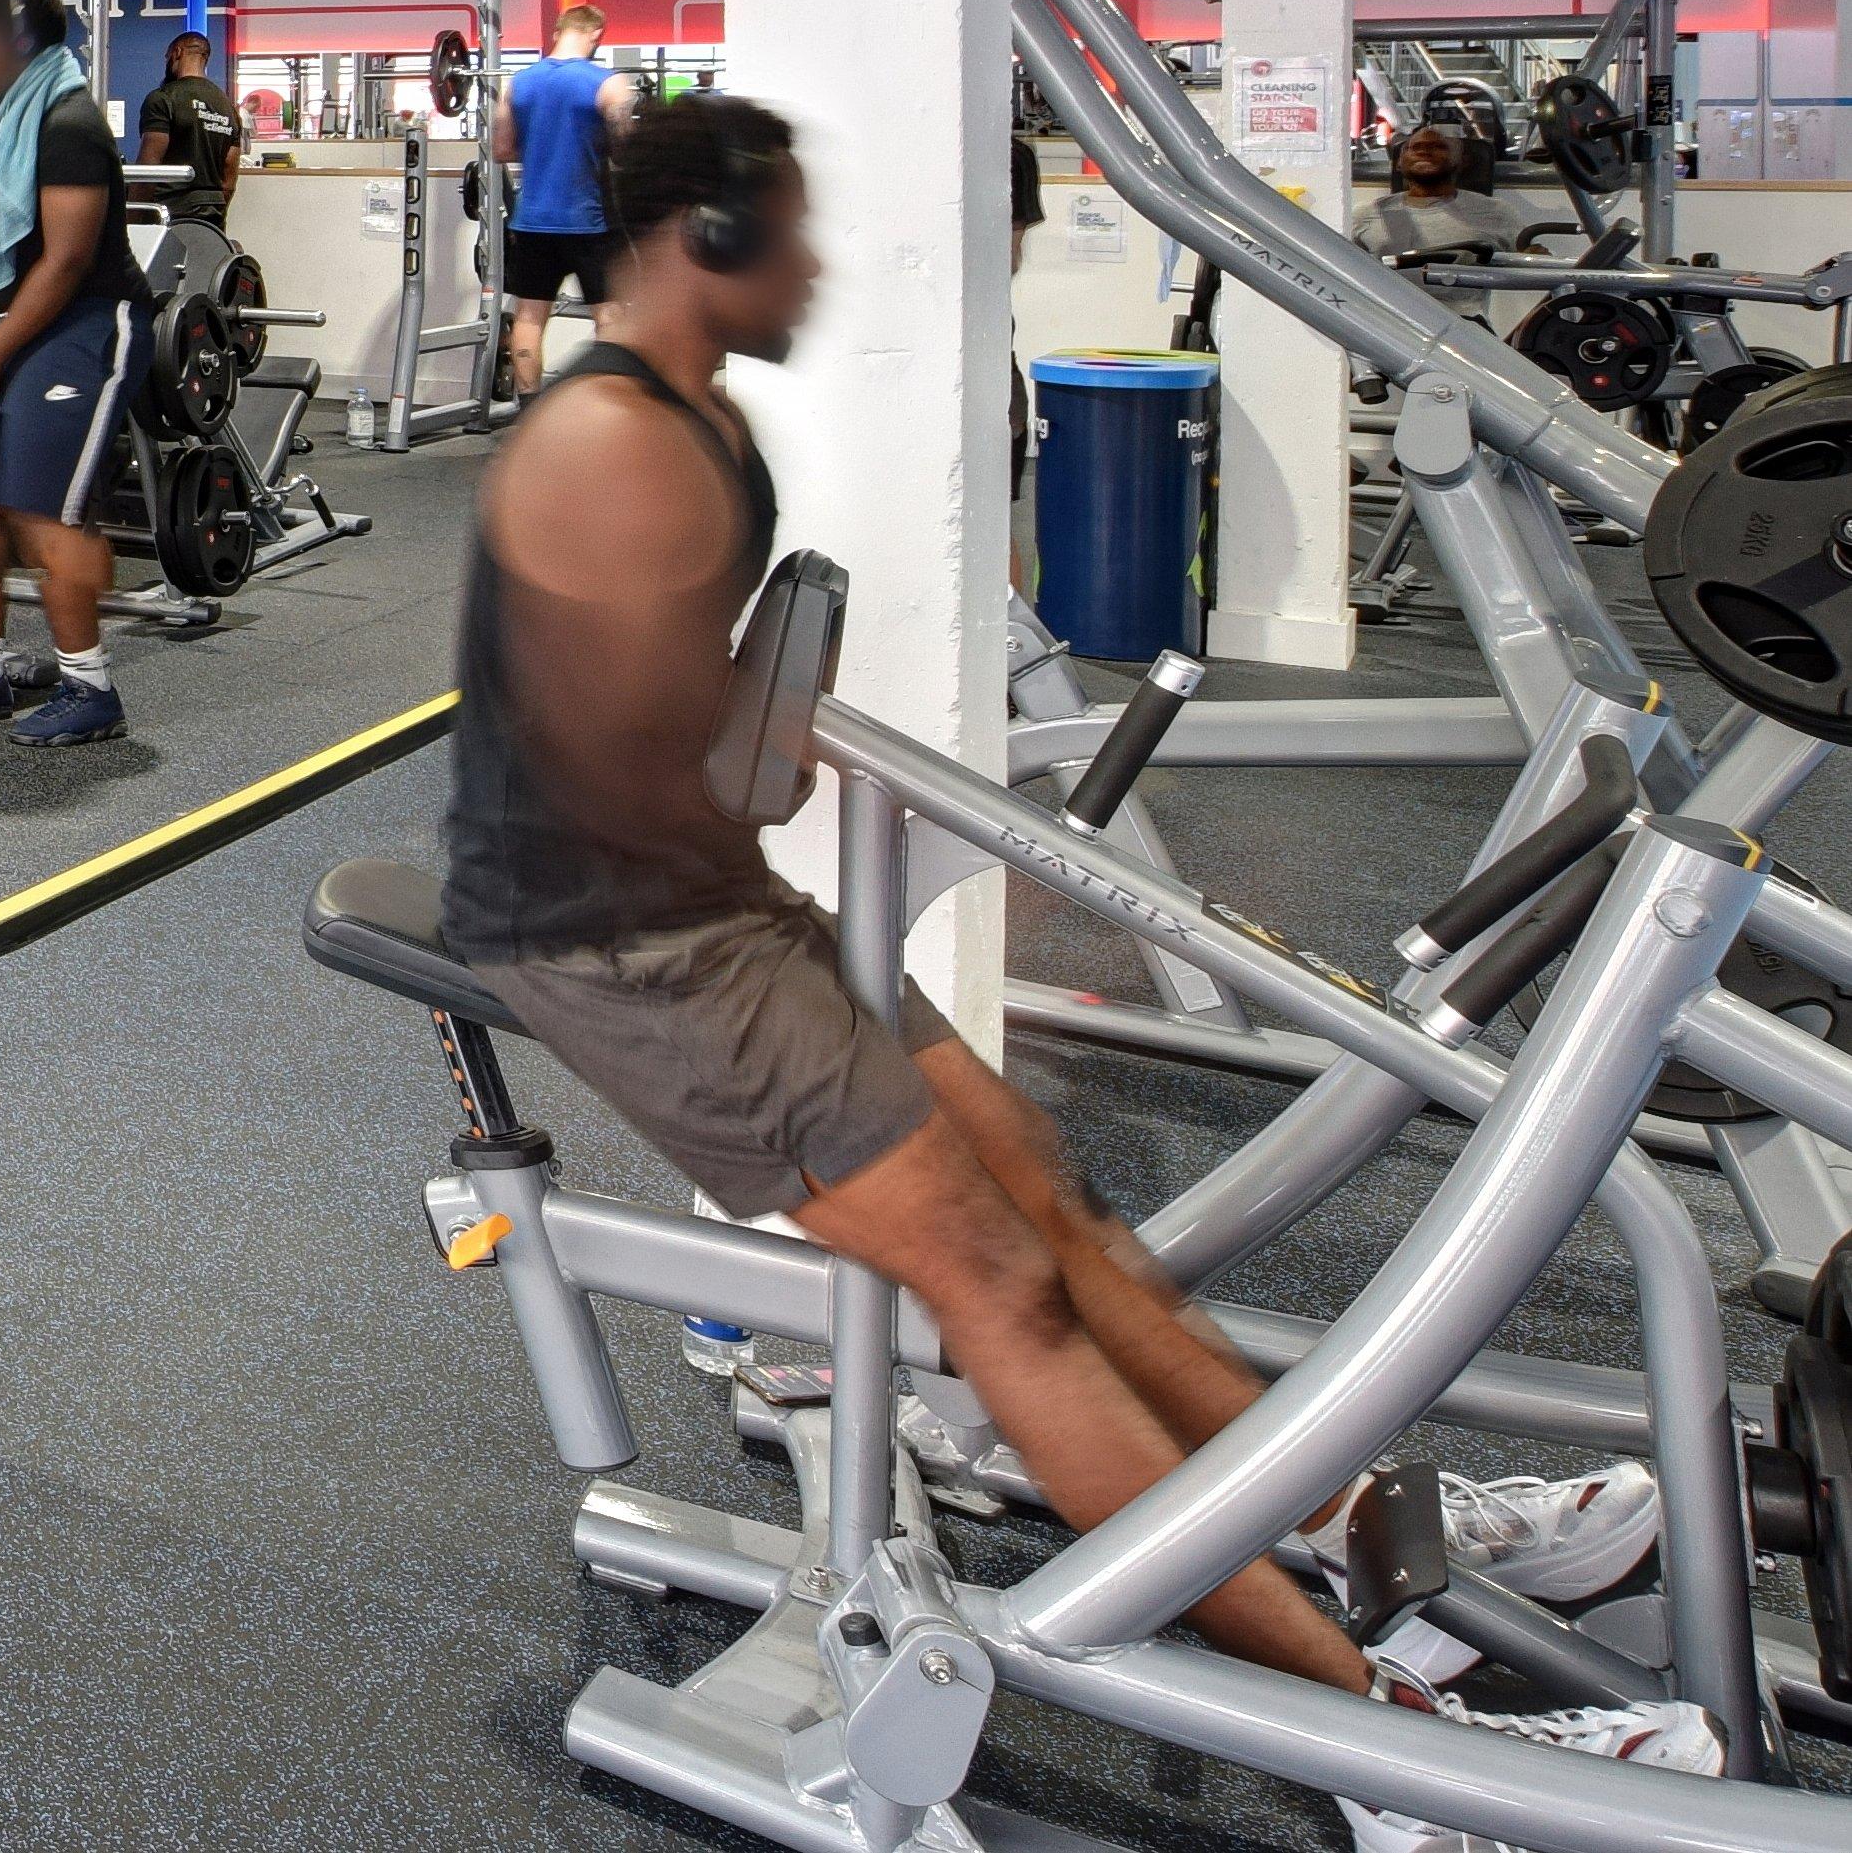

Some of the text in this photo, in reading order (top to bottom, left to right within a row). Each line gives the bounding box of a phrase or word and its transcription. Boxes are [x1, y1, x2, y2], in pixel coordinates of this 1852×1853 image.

[1251, 82, 1317, 93] CLEANING
[1251, 93, 1303, 103] STATION
[1231, 232, 1348, 309] MATRIX
[997, 825, 1200, 945] MATRIX
